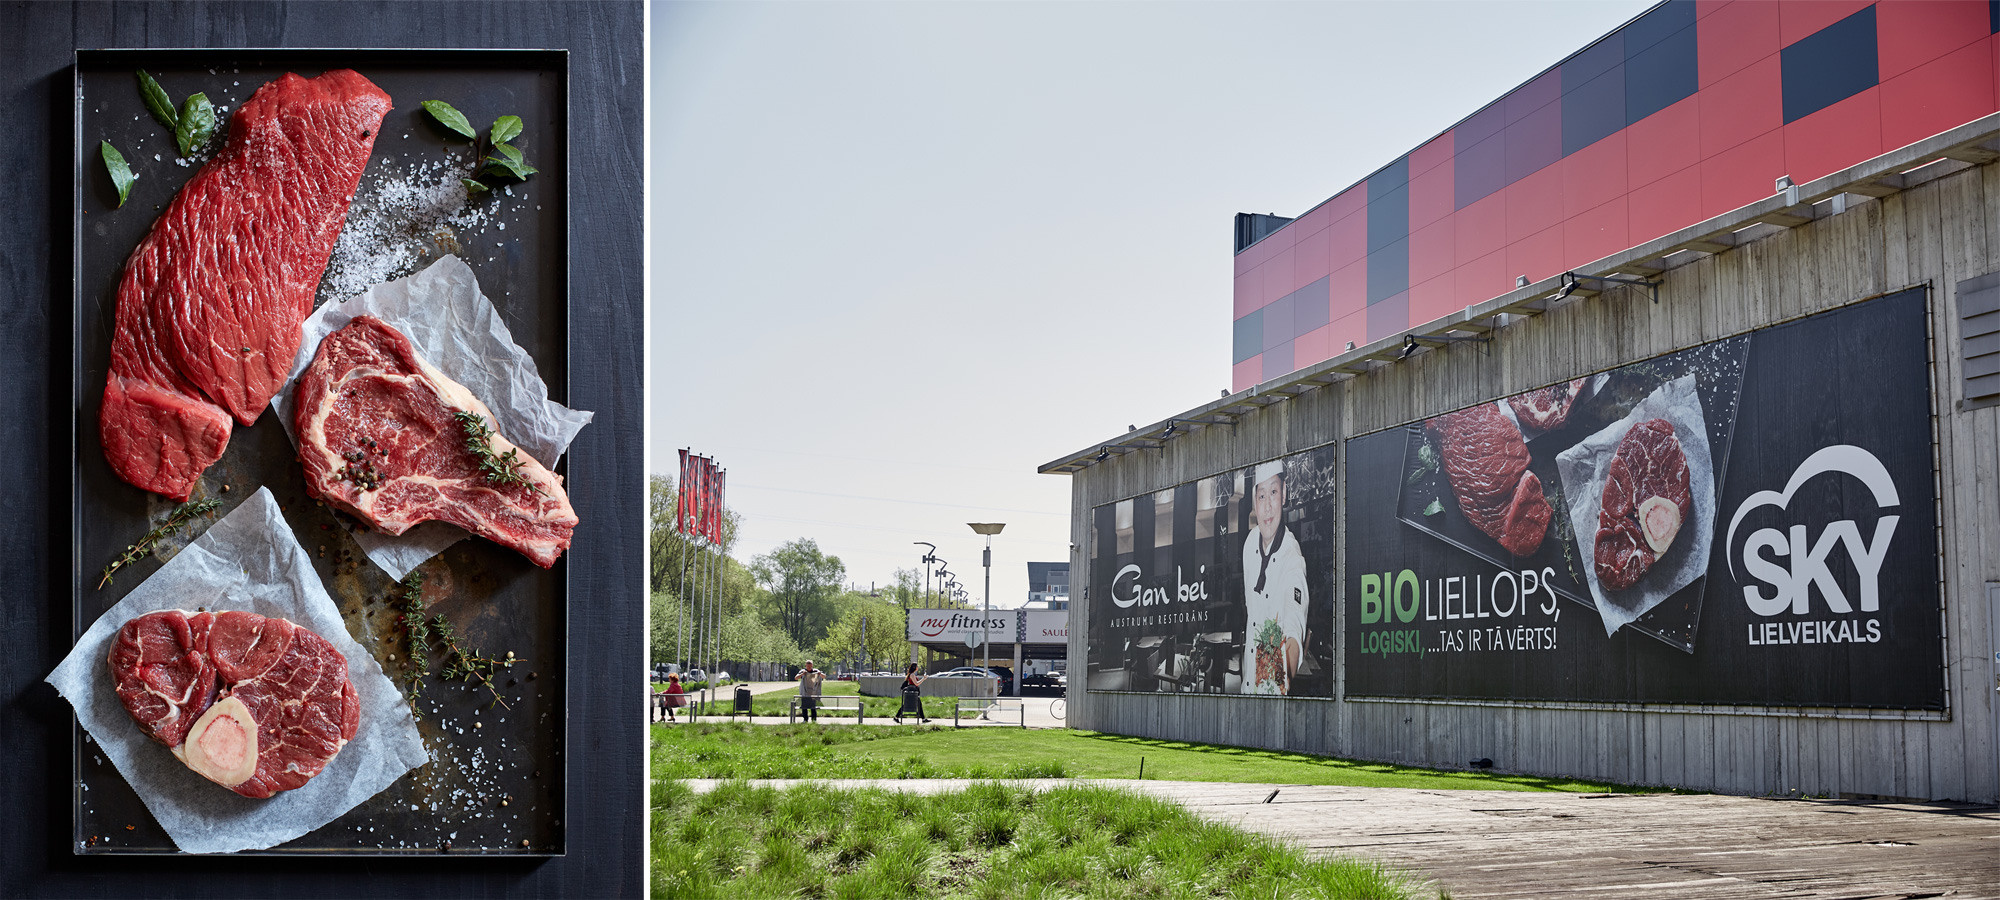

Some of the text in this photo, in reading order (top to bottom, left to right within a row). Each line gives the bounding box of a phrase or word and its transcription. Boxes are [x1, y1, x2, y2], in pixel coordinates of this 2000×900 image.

[1743, 515, 1900, 616] SKY
[1111, 564, 1208, 608] Gan bei
[1361, 567, 1560, 624] BIO LIELLOPS,
[1110, 610, 1209, 628] AUSTRUMU RESTORĀNS
[1748, 618, 1882, 645] LIELVEIKALS
[1469, 629, 1482, 651] IR
[1486, 626, 1504, 651] TĀ
[1507, 625, 1557, 650] VĒRTS!
